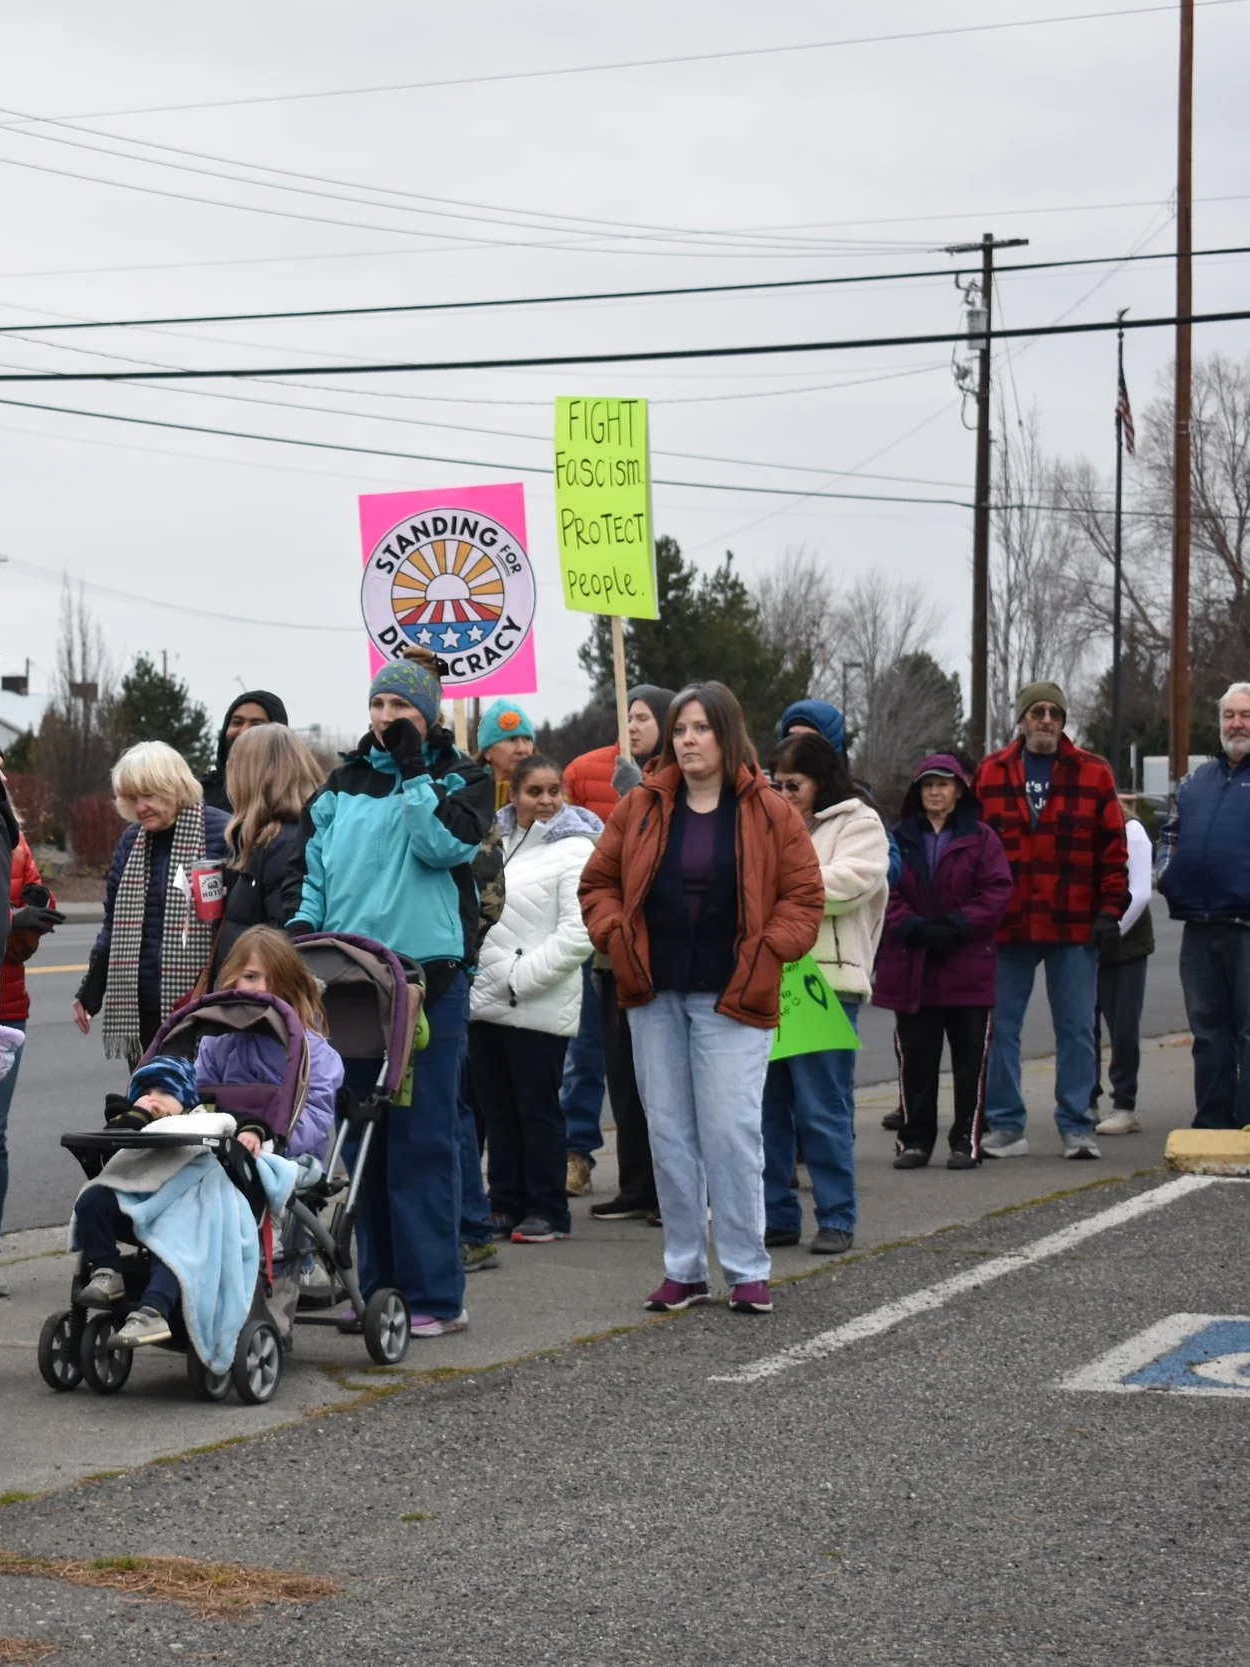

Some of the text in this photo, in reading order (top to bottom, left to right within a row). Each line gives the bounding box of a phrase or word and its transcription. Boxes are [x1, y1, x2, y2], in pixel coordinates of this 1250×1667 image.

[569, 400, 638, 448] FIGHT
[376, 516, 522, 574] STANDING FOR
[561, 508, 644, 550] PROTECT
[378, 615, 521, 677] DECRACY
